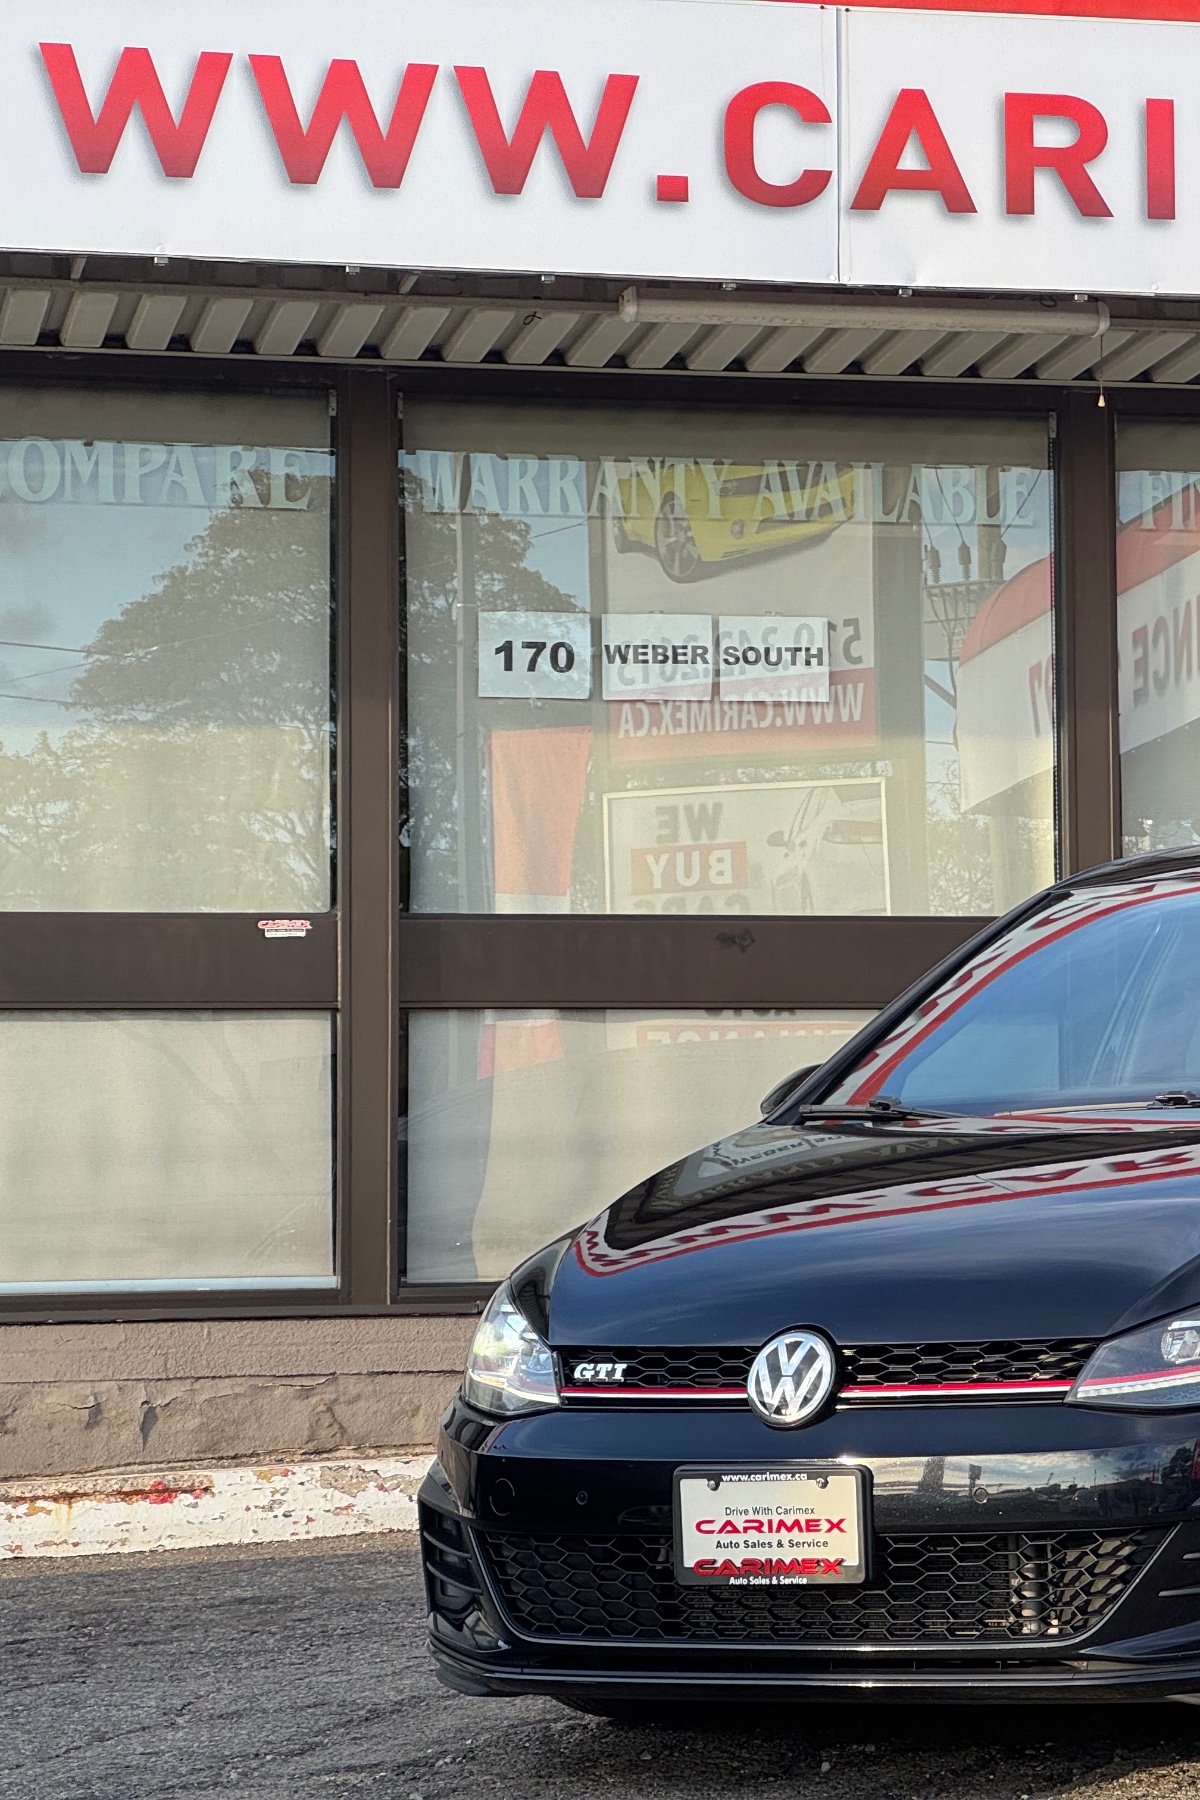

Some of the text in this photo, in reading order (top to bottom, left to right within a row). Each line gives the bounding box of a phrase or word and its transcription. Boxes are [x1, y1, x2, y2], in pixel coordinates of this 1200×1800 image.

[416, 452, 1036, 525] WARRANTY AVAILABLE
[494, 640, 825, 674] 170 WEBER SOUTH
[573, 1363, 628, 1382] GTI
[721, 1472, 808, 1482] www.carimex.ca
[725, 1505, 815, 1516] Drive With Carimex
[695, 1518, 847, 1534] CARIMEX
[715, 1538, 829, 1549] Auto Sales & Service
[693, 1557, 845, 1575] CARIMEX
[729, 1576, 808, 1585] Auto Sales & Service
